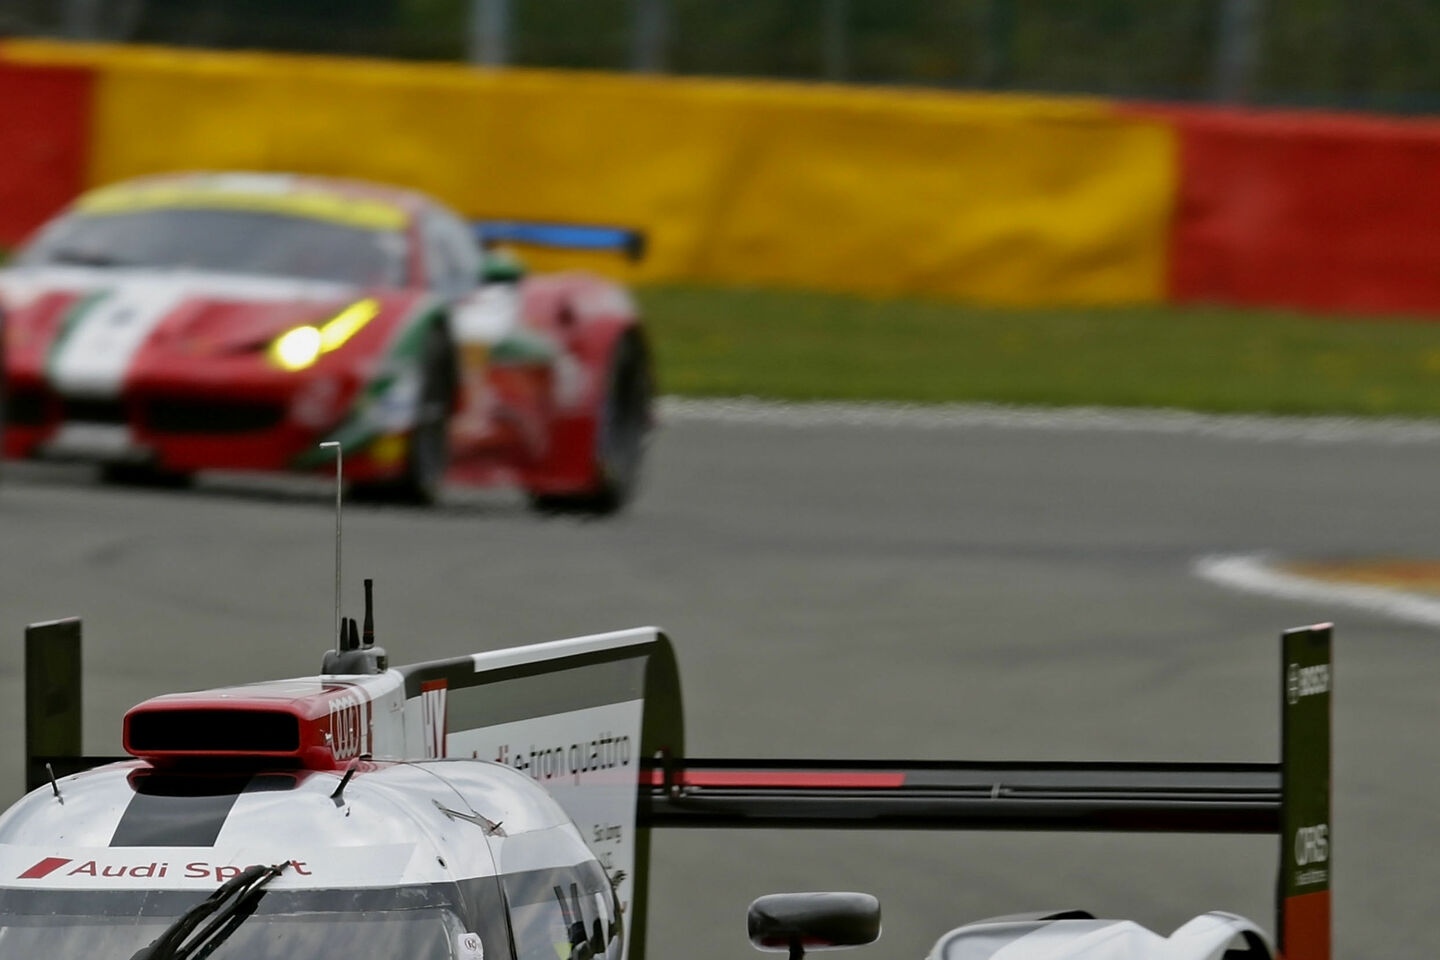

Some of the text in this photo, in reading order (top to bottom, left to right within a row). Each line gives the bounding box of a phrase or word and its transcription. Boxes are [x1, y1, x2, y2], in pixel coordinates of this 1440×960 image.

[568, 732, 632, 786] quattro
[67, 860, 313, 882] Audi Spt
